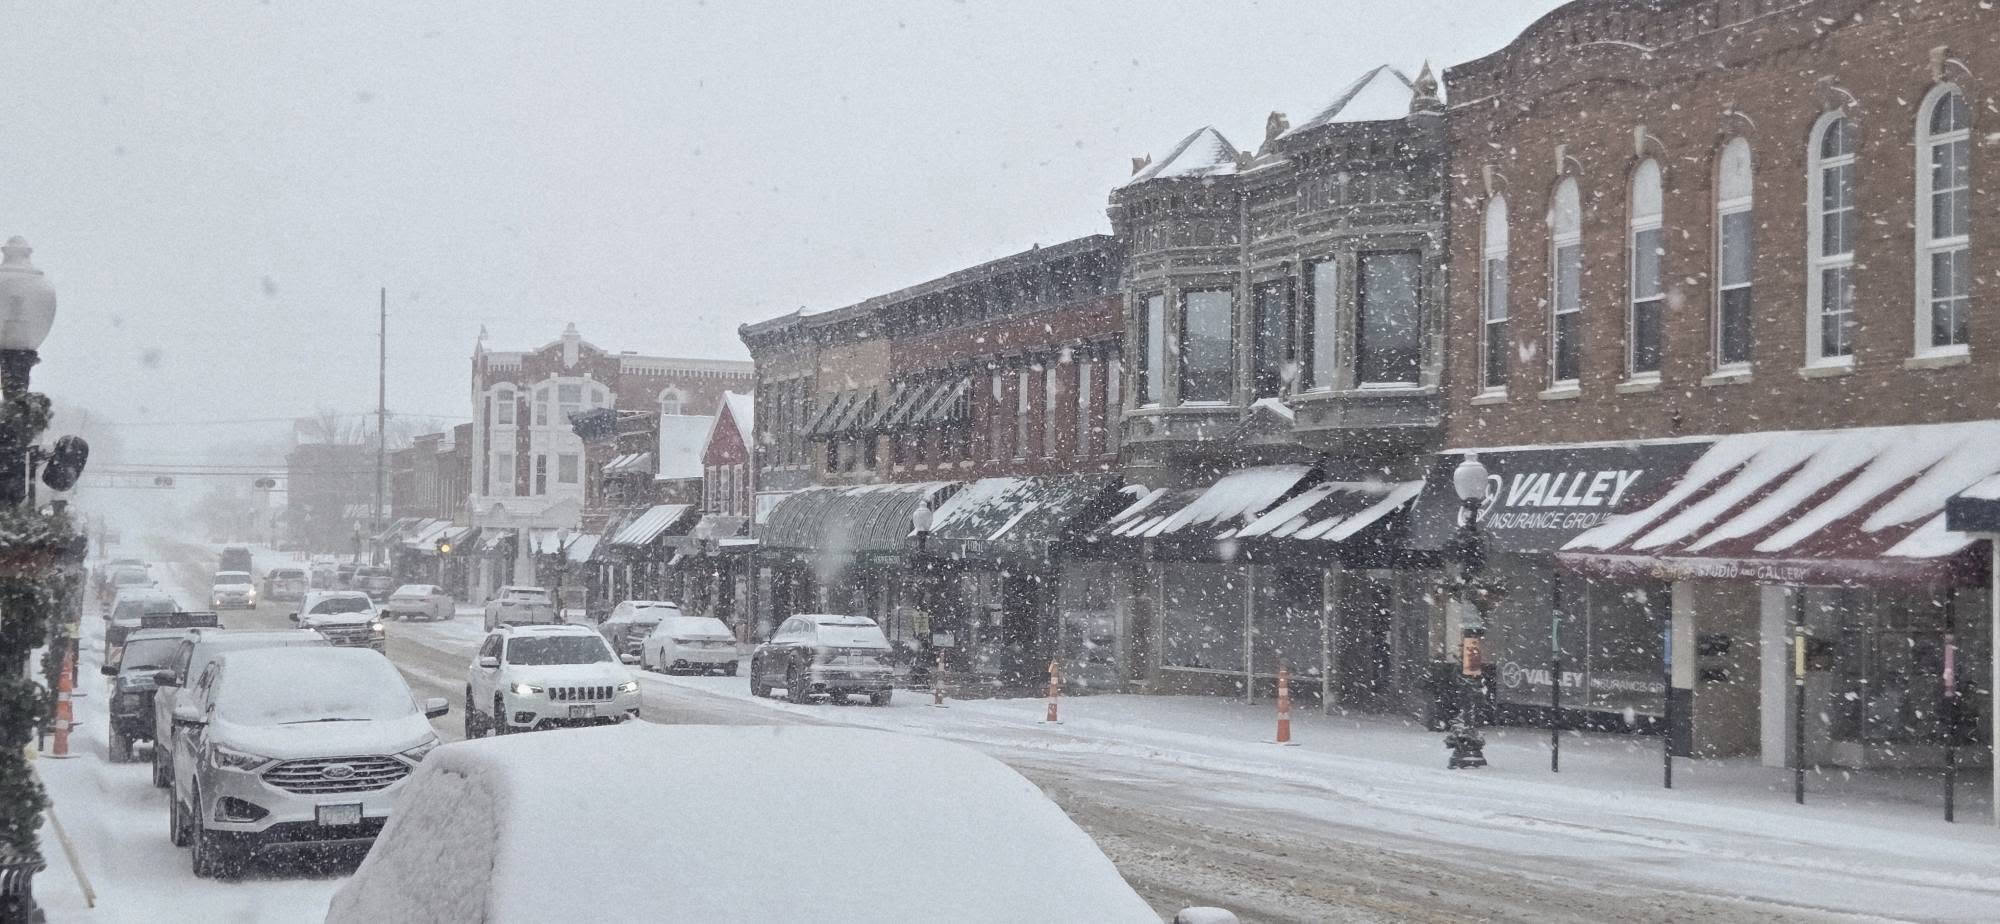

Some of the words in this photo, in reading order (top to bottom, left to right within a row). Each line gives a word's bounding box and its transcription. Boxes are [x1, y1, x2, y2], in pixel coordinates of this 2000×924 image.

[1505, 469, 1644, 507] VALLEY
[1487, 512, 1564, 529] INSURANCE
[1757, 565, 1807, 581] GALLERY
